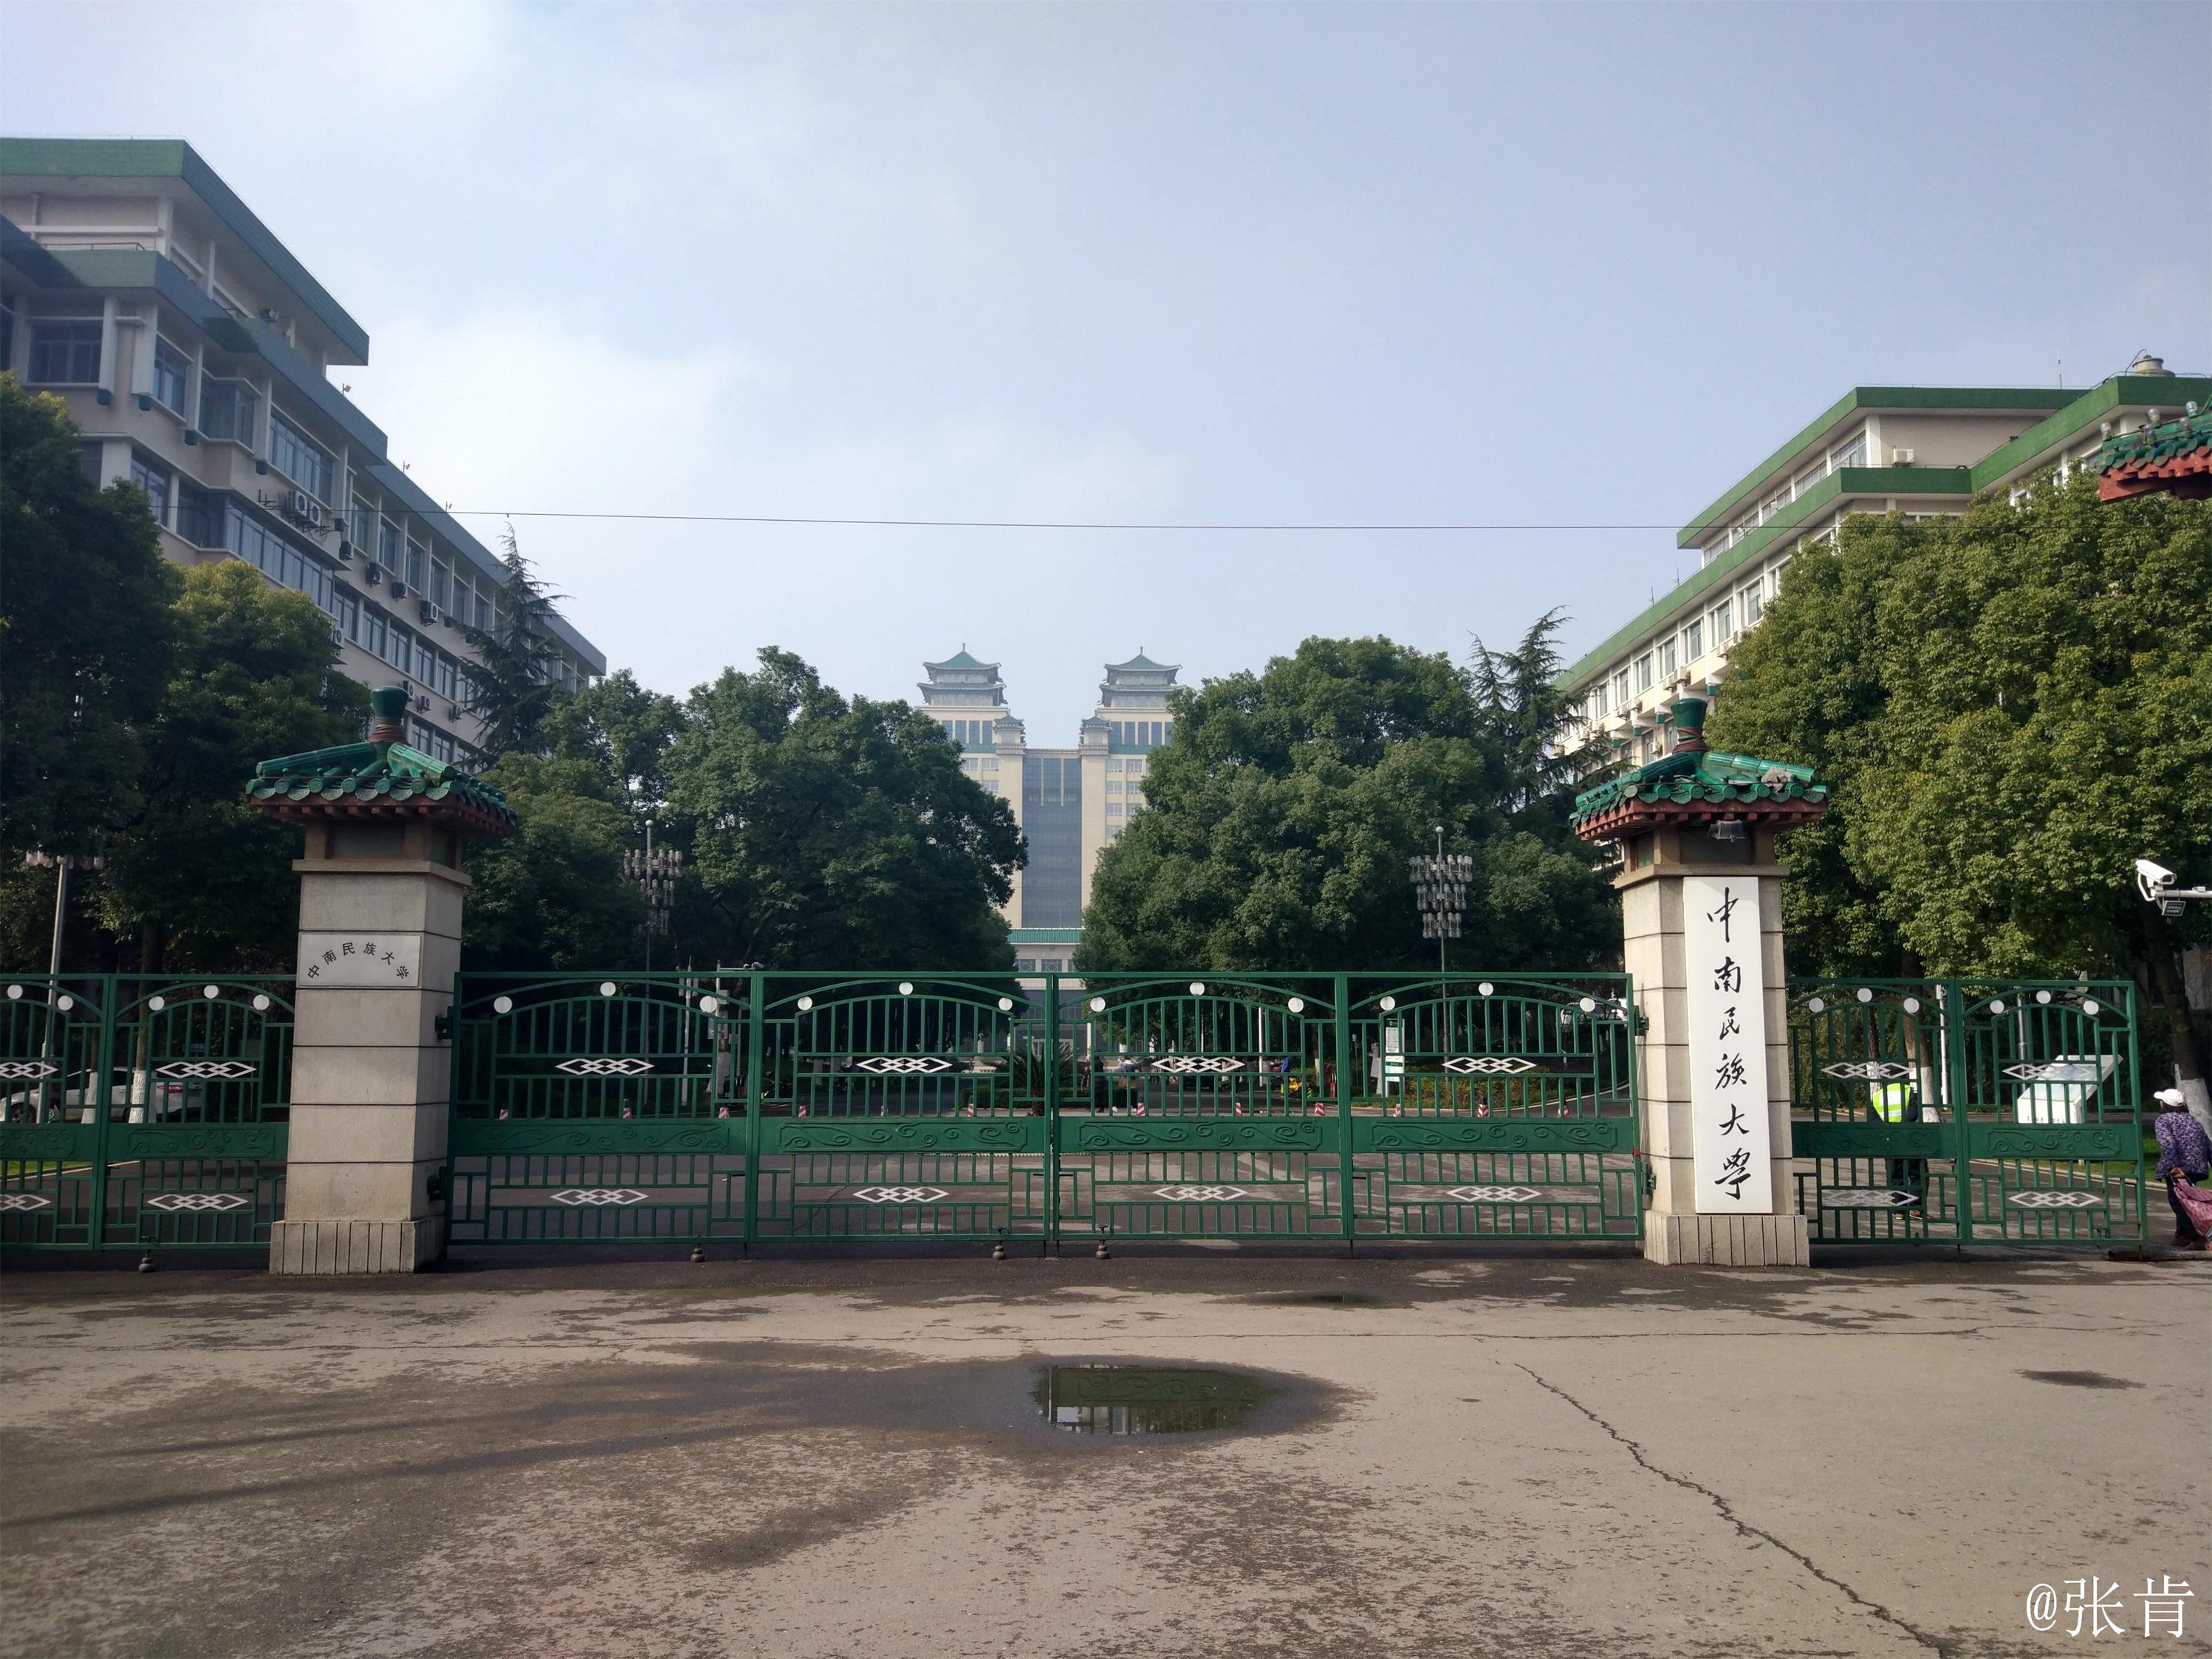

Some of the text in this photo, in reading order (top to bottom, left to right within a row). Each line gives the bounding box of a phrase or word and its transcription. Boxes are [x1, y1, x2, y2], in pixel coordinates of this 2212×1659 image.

[307, 942, 410, 980] 中南民族大学
